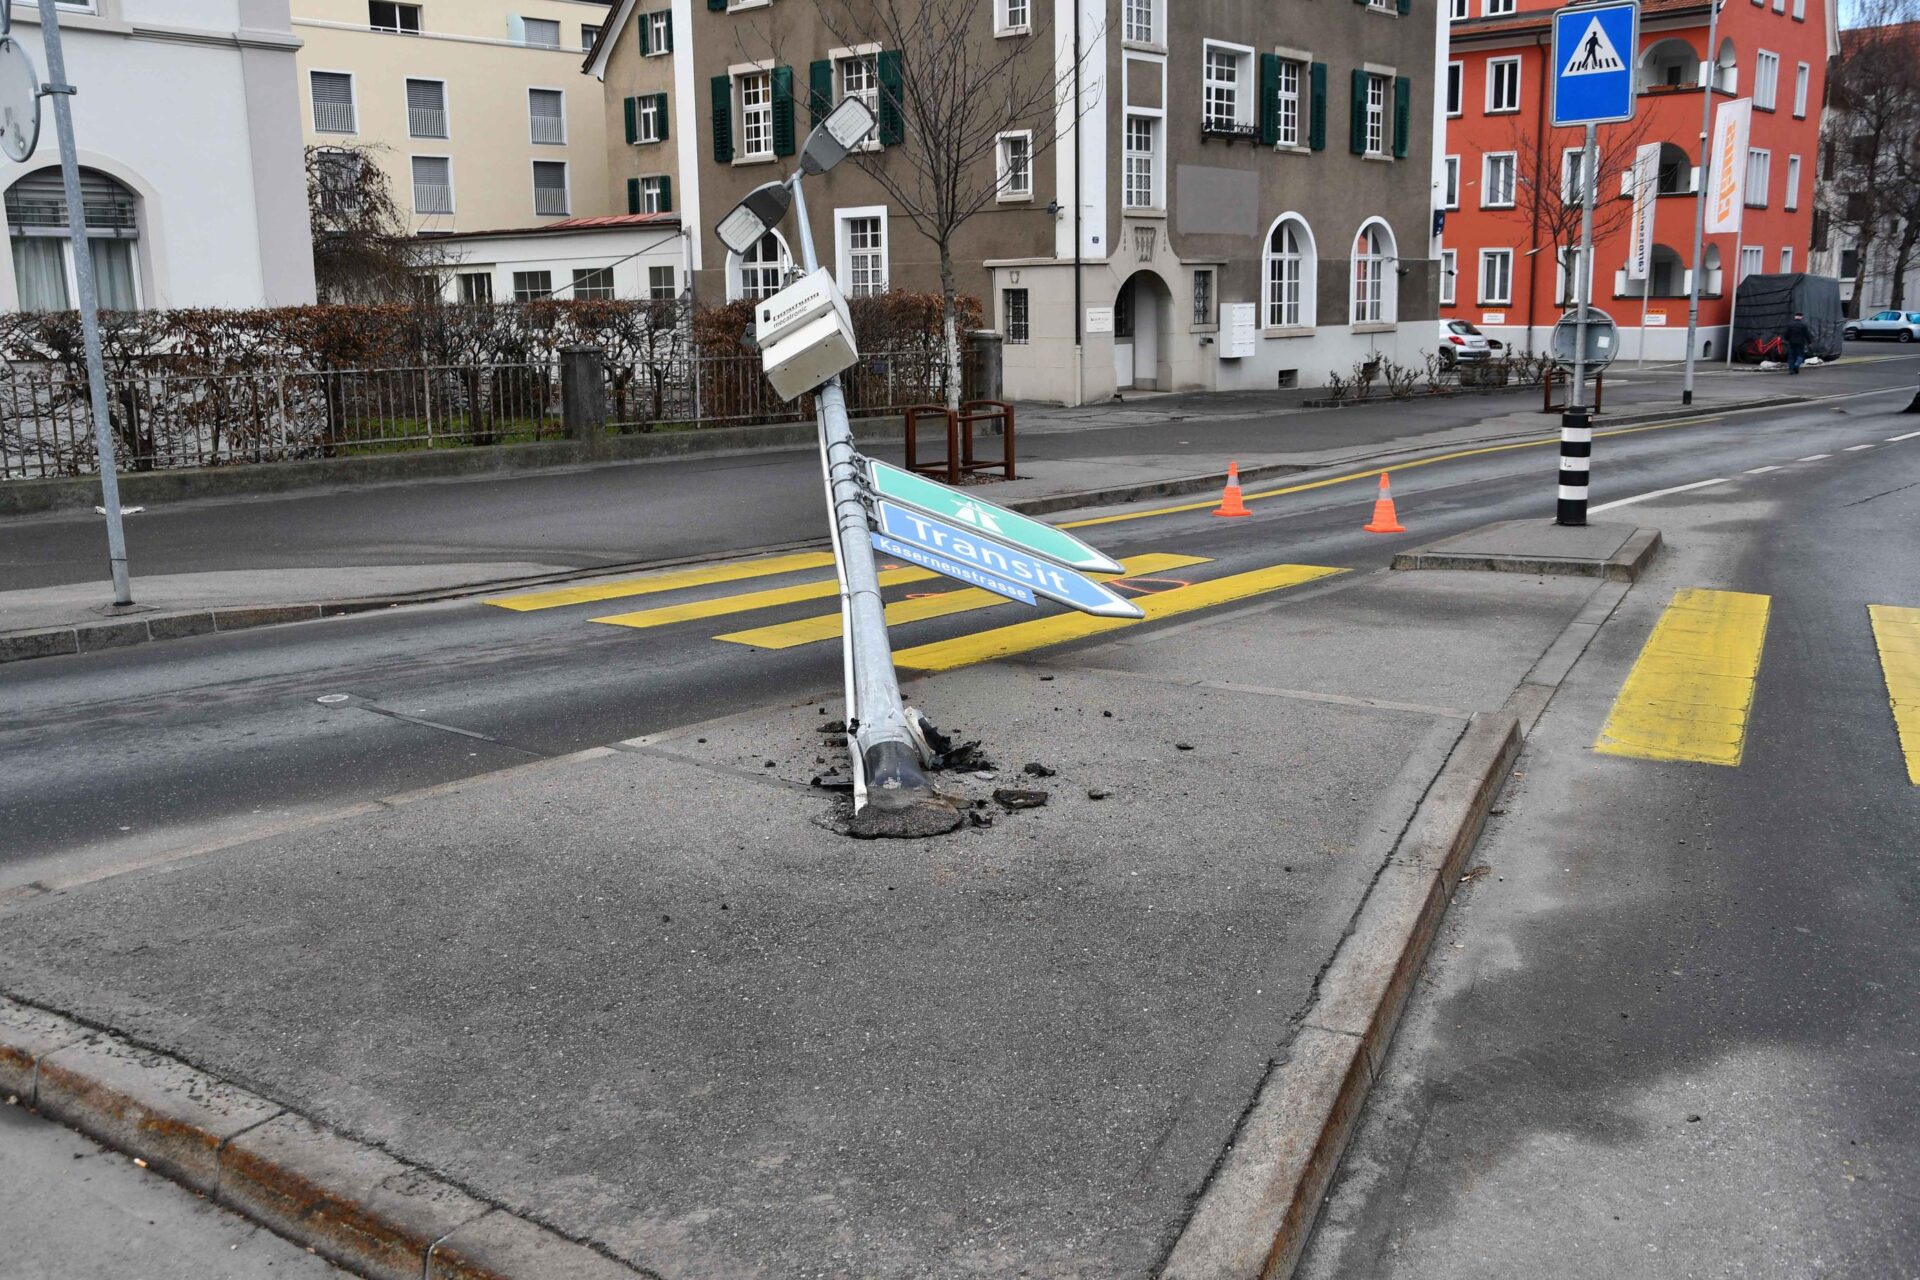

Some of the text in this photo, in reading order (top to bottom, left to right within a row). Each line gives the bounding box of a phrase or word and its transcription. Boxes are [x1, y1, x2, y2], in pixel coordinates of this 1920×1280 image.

[773, 305, 808, 329] mecatronic
[880, 538, 1027, 599] Kasernenstrasse
[906, 515, 1069, 594] Transit
